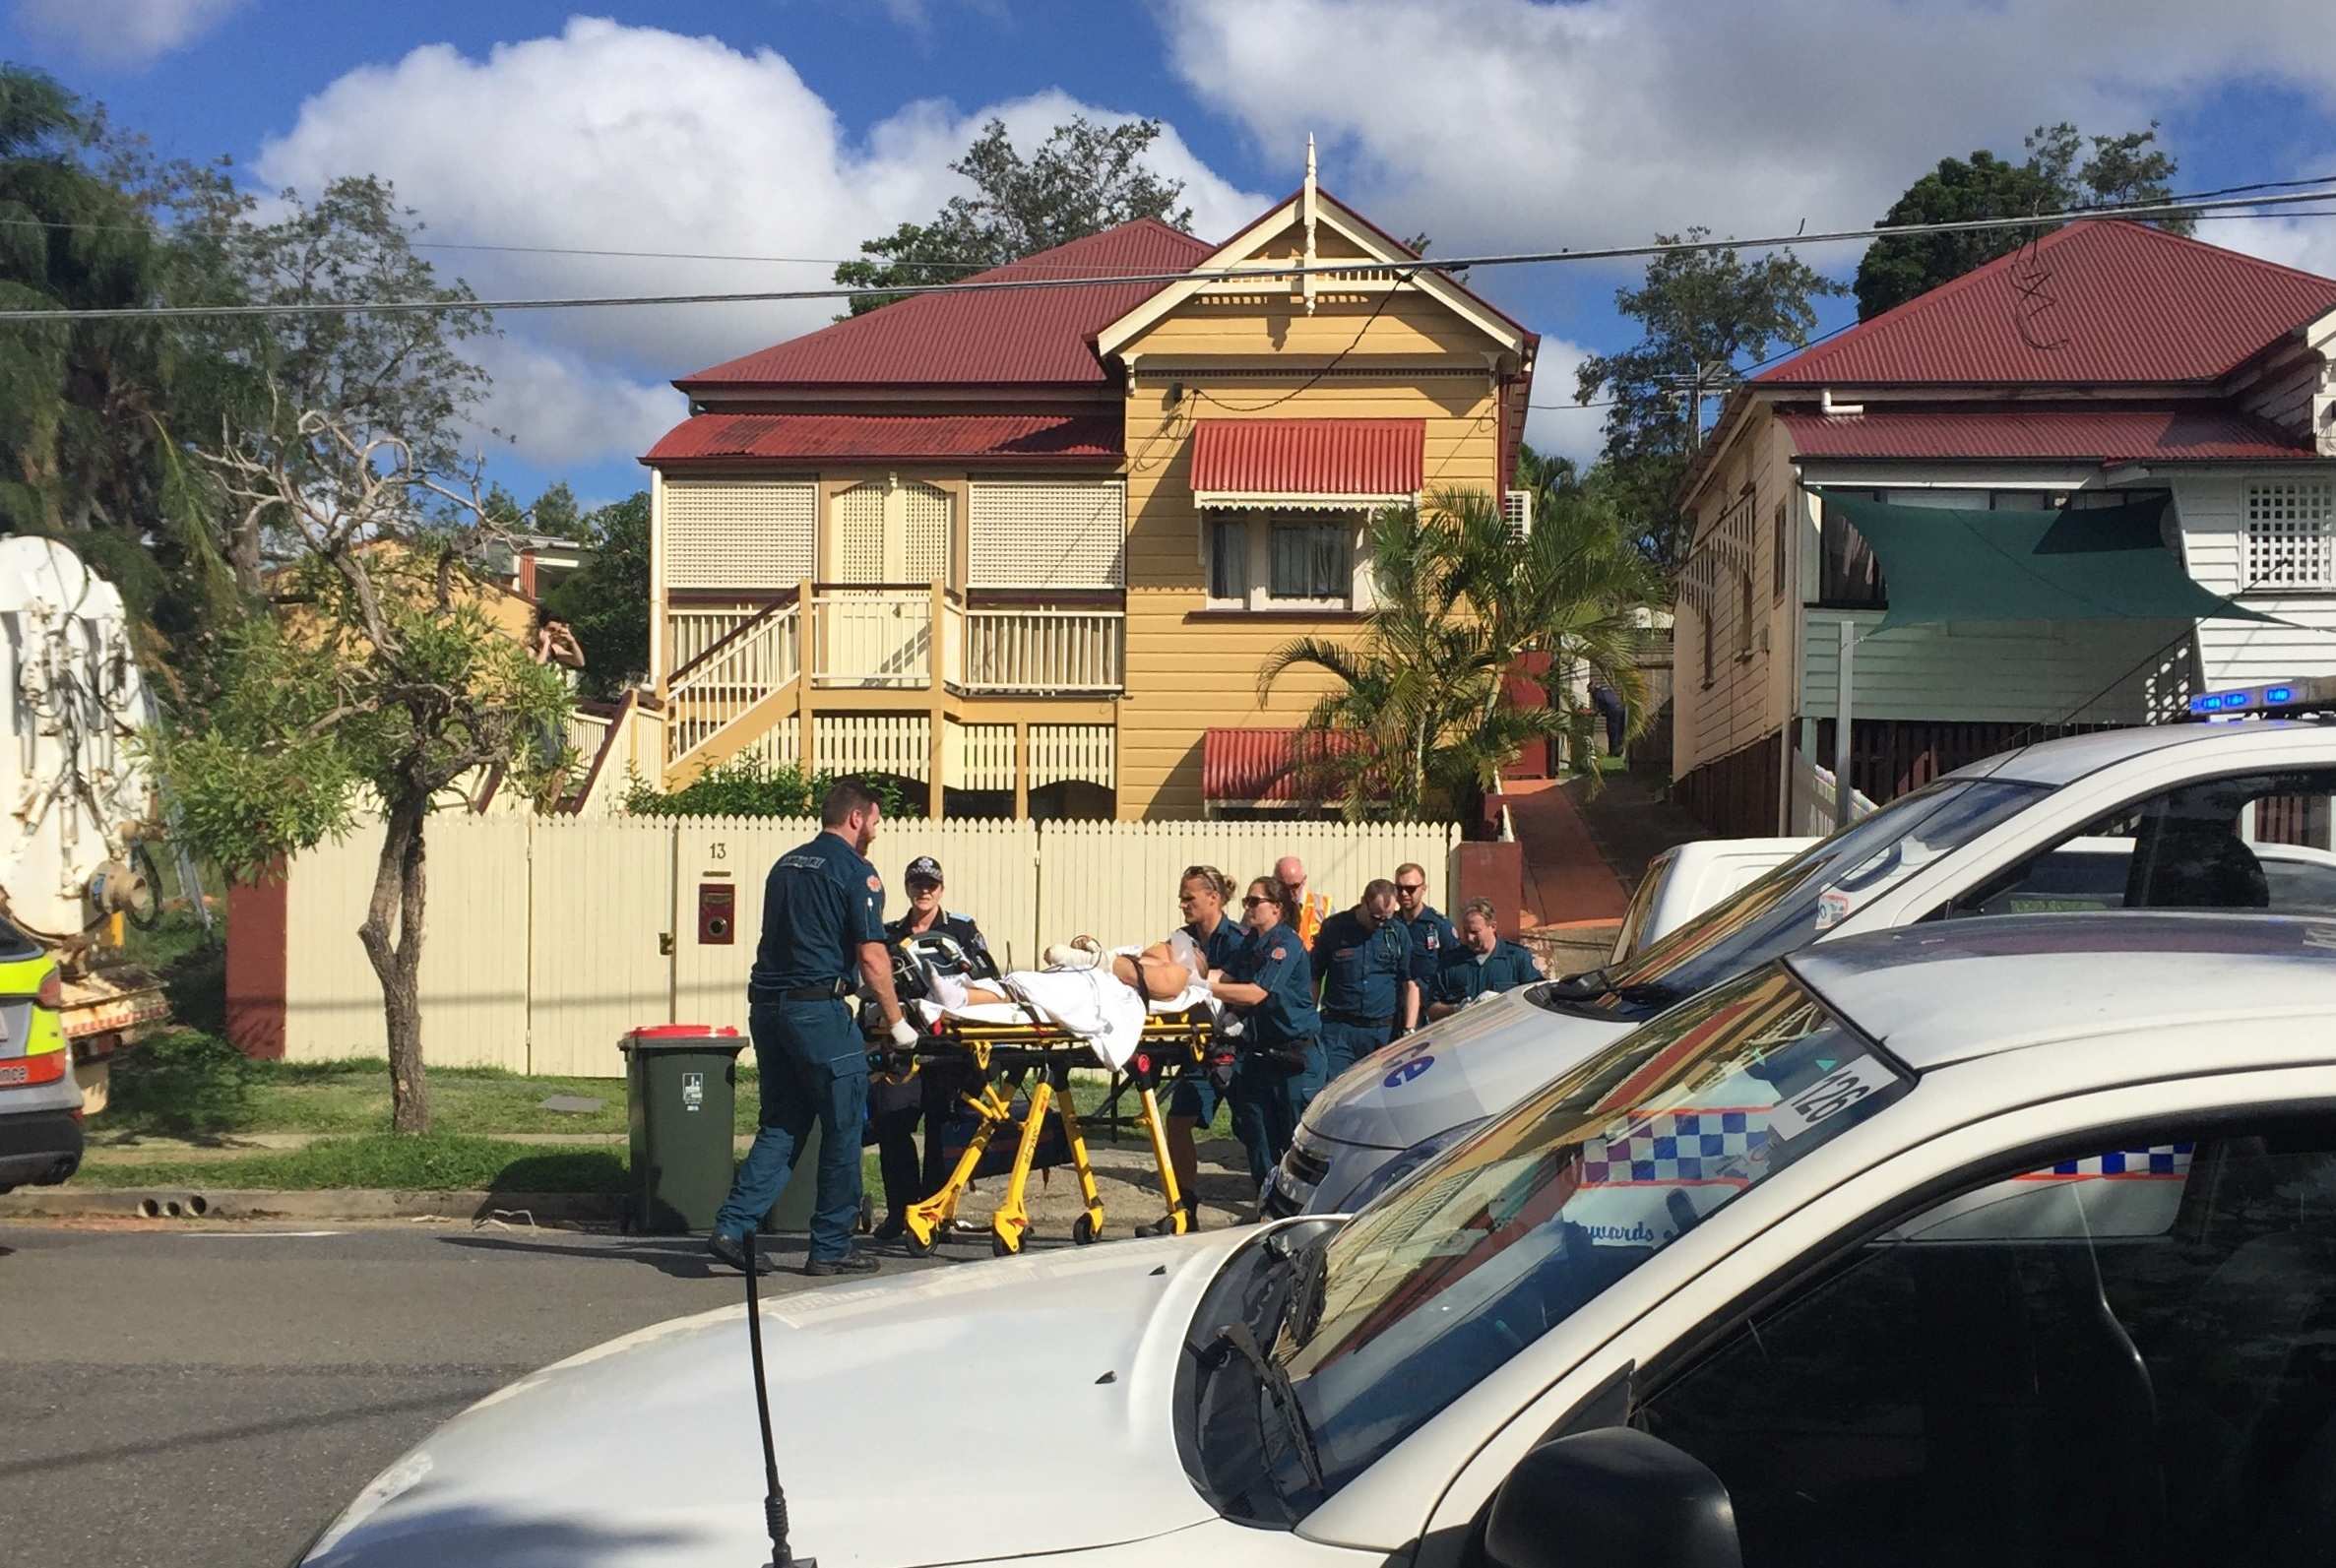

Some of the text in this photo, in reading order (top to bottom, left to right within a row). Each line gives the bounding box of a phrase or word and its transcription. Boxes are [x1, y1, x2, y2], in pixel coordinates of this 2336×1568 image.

[709, 843, 726, 859] 13
[1790, 1070, 1871, 1123] 126
[1581, 1221, 1655, 1241] wards
